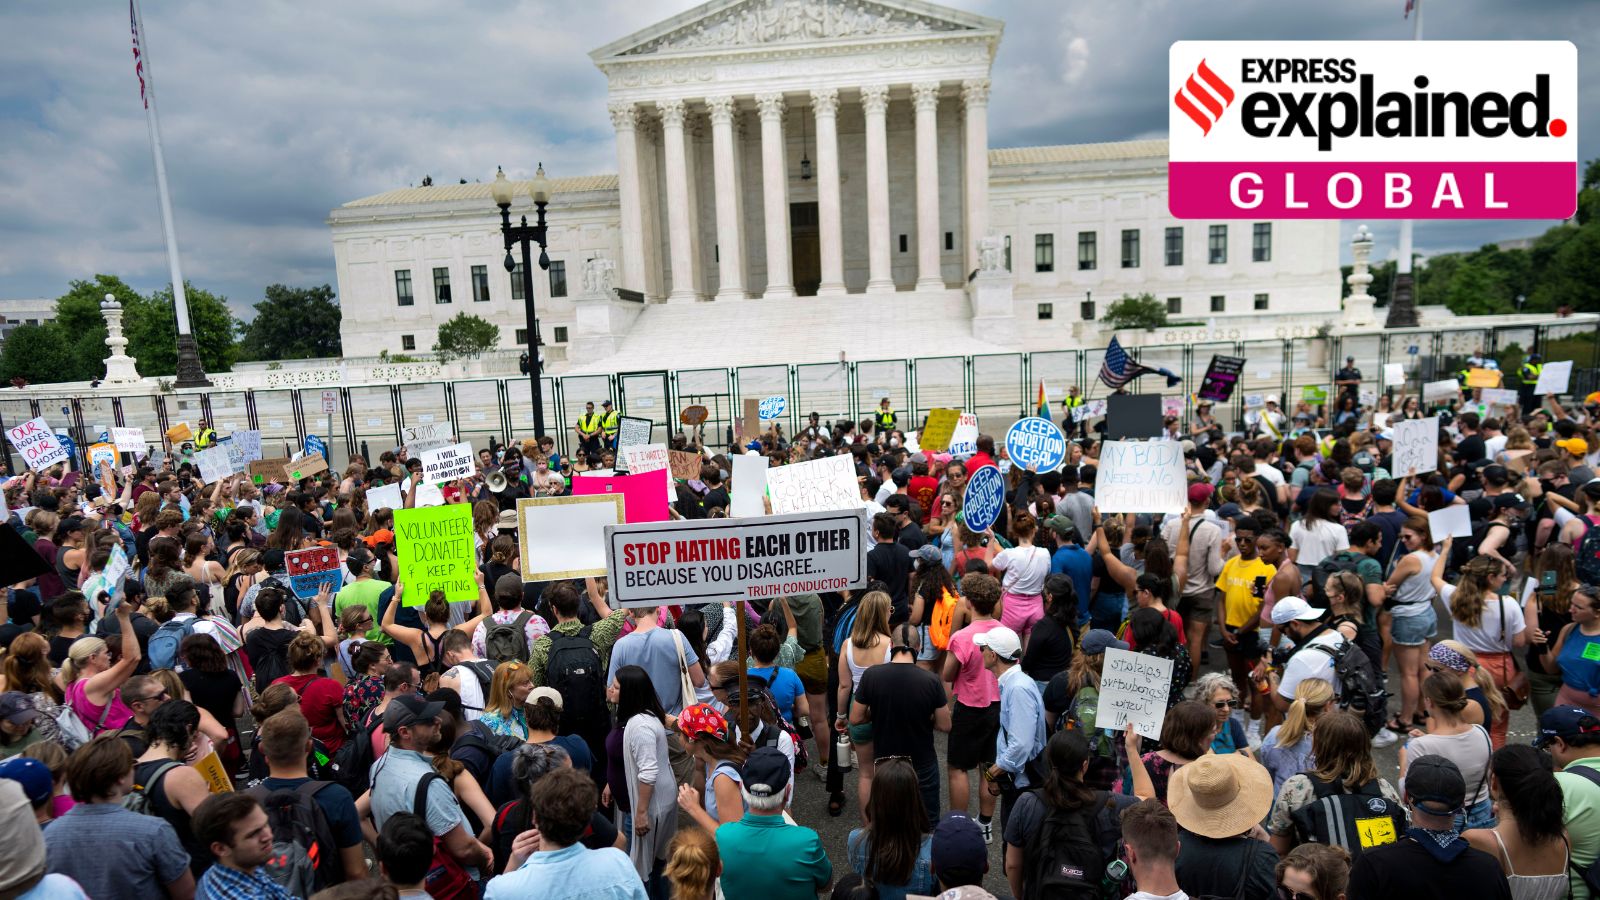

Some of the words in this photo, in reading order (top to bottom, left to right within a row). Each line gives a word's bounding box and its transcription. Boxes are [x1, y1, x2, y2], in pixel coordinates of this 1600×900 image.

[12, 421, 42, 440] OUR
[1021, 419, 1057, 437] KEEP
[16, 431, 51, 450] BODIES
[27, 440, 55, 459] OUR
[1009, 430, 1063, 455] ABORTION
[426, 463, 438, 472] AID
[440, 460, 454, 470] AND
[454, 456, 471, 466] ABET
[441, 449, 458, 460] WILL
[1013, 445, 1056, 467] LEGAL
[1101, 445, 1126, 467] MY
[1131, 444, 1180, 467] BODY
[968, 468, 992, 499] KEEP
[1103, 467, 1144, 485] NEEDS
[1147, 466, 1174, 486] NO
[965, 473, 1002, 520] ABORTION
[972, 494, 1001, 527] LEGAL
[400, 517, 473, 540] VOLUNTEER,
[413, 538, 470, 562] DONATE!
[623, 541, 671, 567] STOP
[675, 537, 741, 563] HATING
[745, 533, 791, 559] EACH
[795, 528, 850, 555] OTHER
[427, 563, 456, 577] KEEP
[625, 567, 698, 588] BECAUSE
[702, 564, 732, 583] YOU
[737, 557, 826, 581] DISAGREE...
[416, 579, 471, 596] FIGHTING
[747, 583, 781, 598] TRUTH
[783, 577, 848, 594] CONDUCTOR
